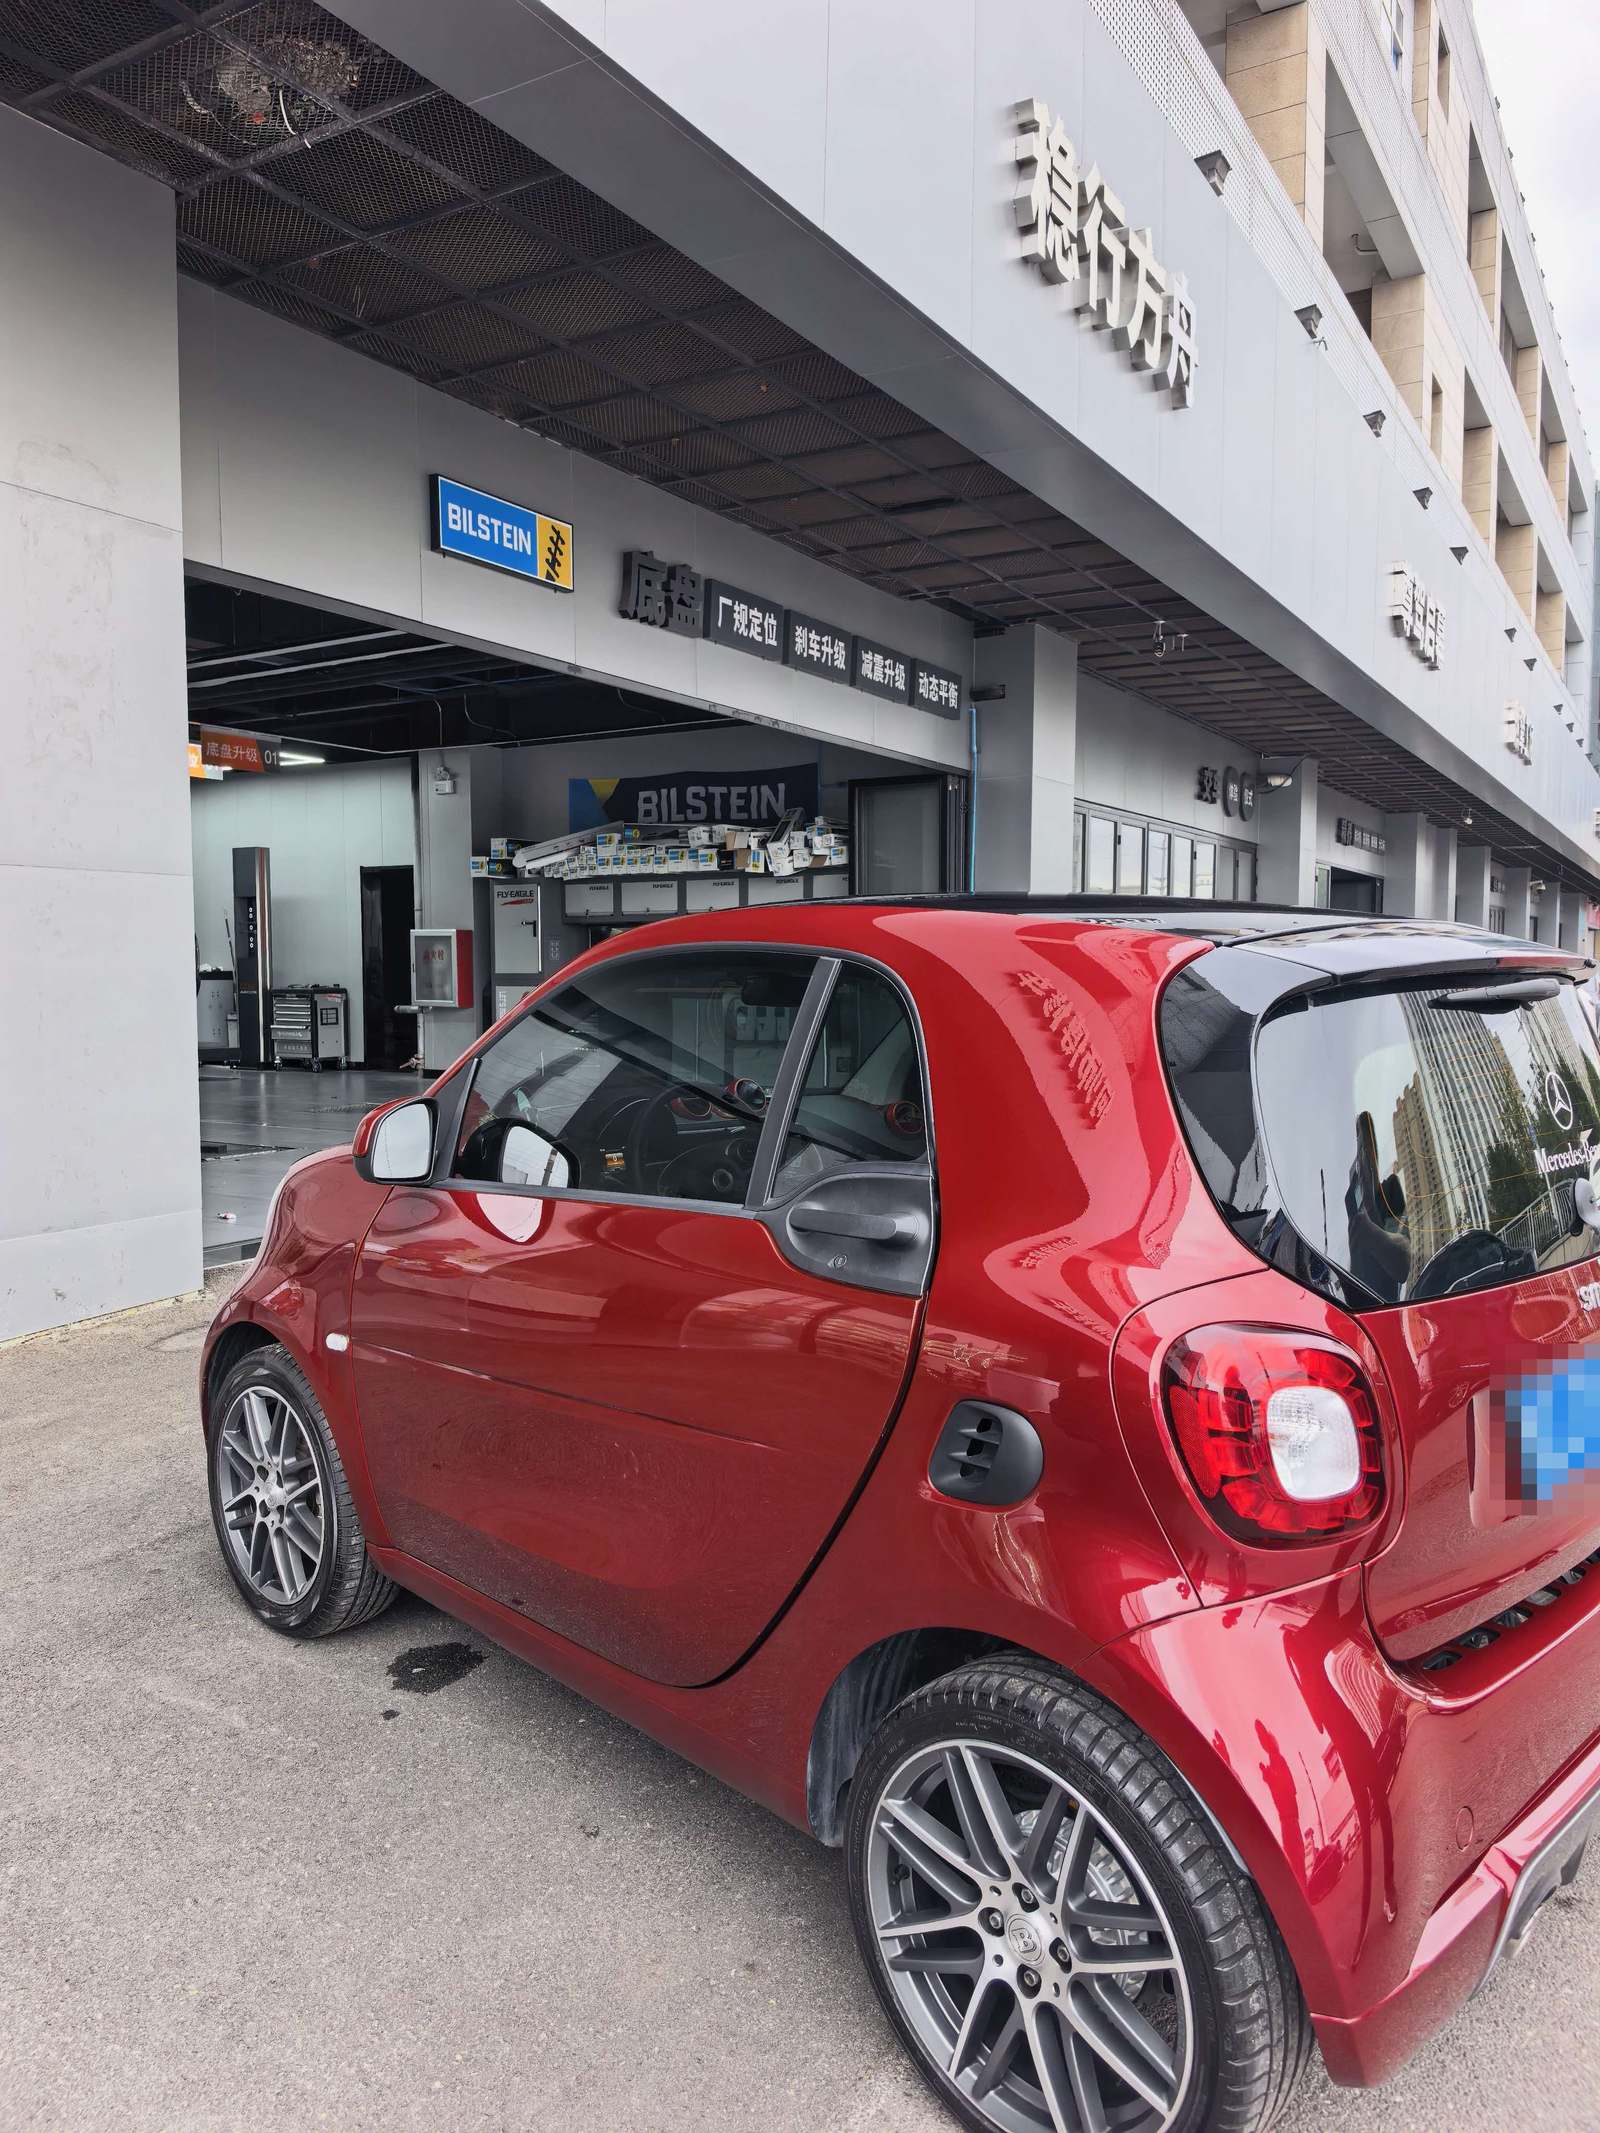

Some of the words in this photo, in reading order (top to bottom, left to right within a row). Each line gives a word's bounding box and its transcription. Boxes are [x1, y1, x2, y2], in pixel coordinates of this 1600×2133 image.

[1014, 98, 1199, 411] 稳行方舟
[448, 502, 532, 556] BILSTEIN
[618, 551, 702, 638] 底盘
[717, 595, 778, 647] 厂规定位
[794, 625, 846, 671] 刹车升级
[861, 650, 906, 692] 减震升级
[918, 671, 959, 710] 动态平衡
[206, 742, 258, 763] 底盘升级
[637, 783, 786, 824] BILSTEIN
